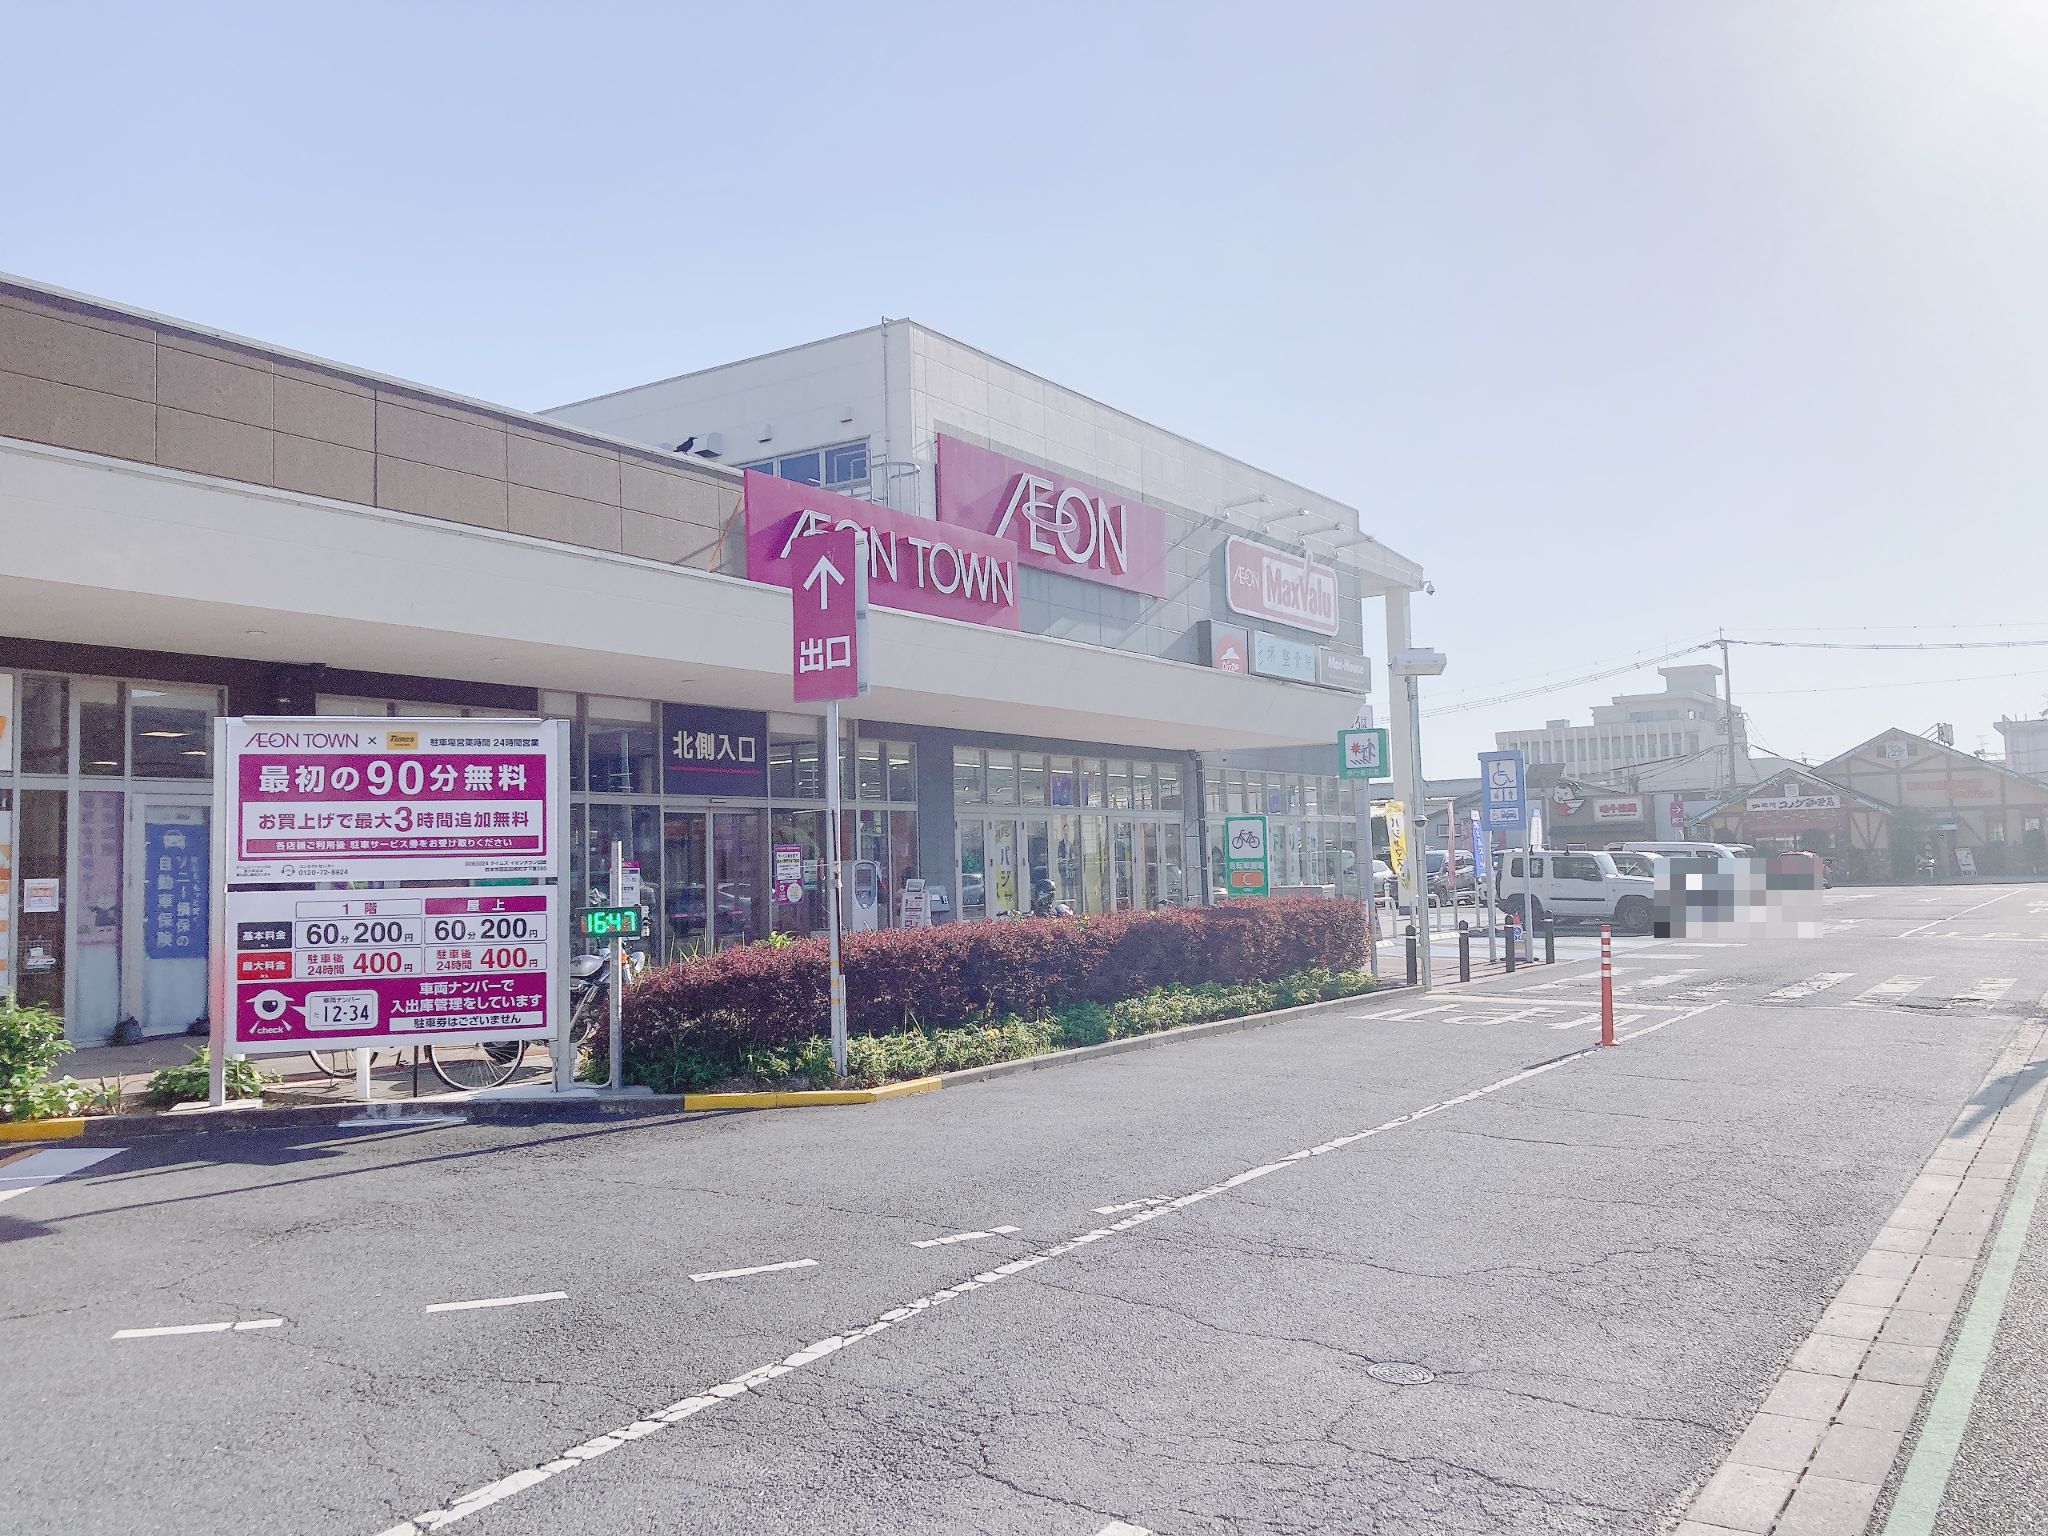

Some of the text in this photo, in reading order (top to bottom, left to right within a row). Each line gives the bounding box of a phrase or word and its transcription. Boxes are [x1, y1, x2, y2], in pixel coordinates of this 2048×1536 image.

[907, 536, 1014, 607] TOWN
[1266, 553, 1332, 618] MaxValu
[799, 635, 851, 674] 出口
[303, 733, 359, 748] TOWN
[430, 738, 540, 747] 駐車場営業時間 24時間営業
[672, 730, 756, 763] 北側入口
[258, 759, 527, 796] 最初の90分無料
[258, 806, 529, 833] お買上げで最大3時間追加無料
[157, 855, 174, 947] 自動車保険
[242, 930, 287, 941] 基本料金
[307, 953, 344, 964] 駐車後
[436, 949, 472, 960] 駐車後
[242, 960, 287, 971] 最大料金
[307, 964, 345, 975] 24時間
[436, 960, 472, 971] 24時間
[419, 979, 515, 996] 車両ナンバーで
[390, 994, 543, 1014] 入出庫管理をしています
[413, 1014, 521, 1029] 駐車券はございません
[256, 1026, 284, 1034] check
